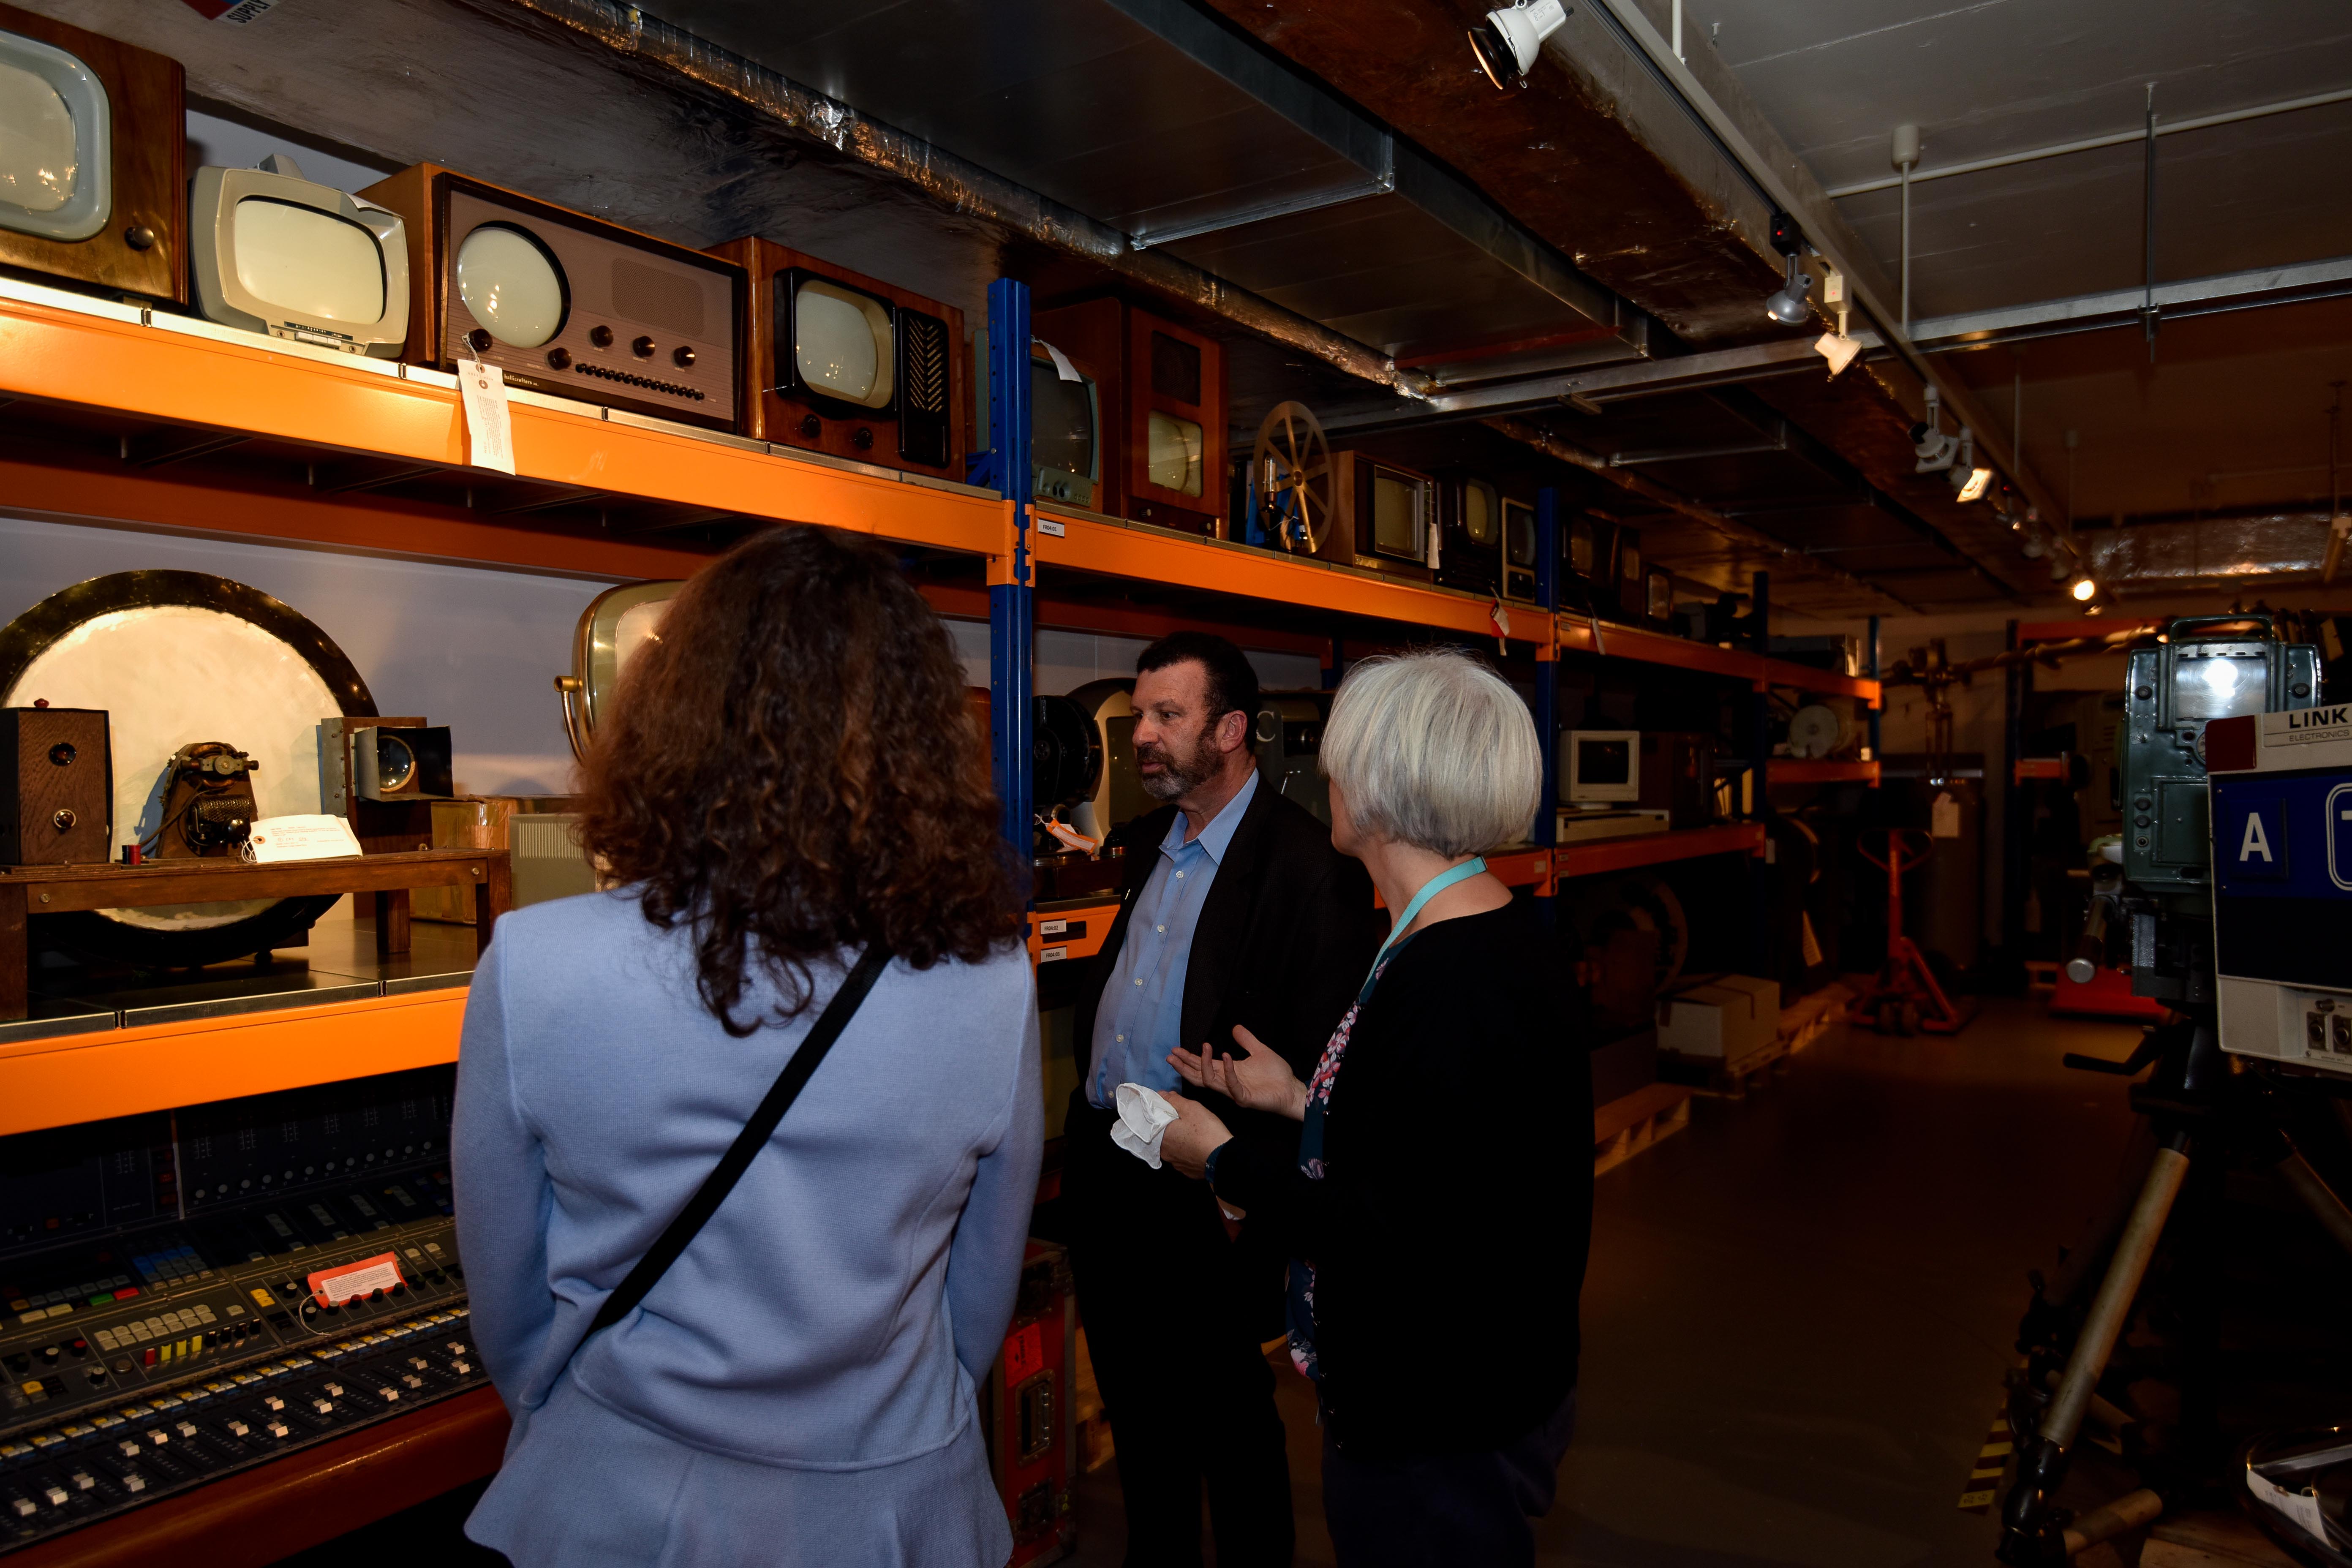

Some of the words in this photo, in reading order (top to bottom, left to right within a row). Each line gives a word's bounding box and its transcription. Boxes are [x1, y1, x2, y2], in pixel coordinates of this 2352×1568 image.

[227, 0, 271, 23] SUPPLY
[504, 373, 532, 385] hallicrafters
[1256, 710, 1275, 742] C
[2289, 707, 2348, 728] LINK
[2289, 730, 2349, 741] ELECTRONICS
[2239, 811, 2273, 862] A
